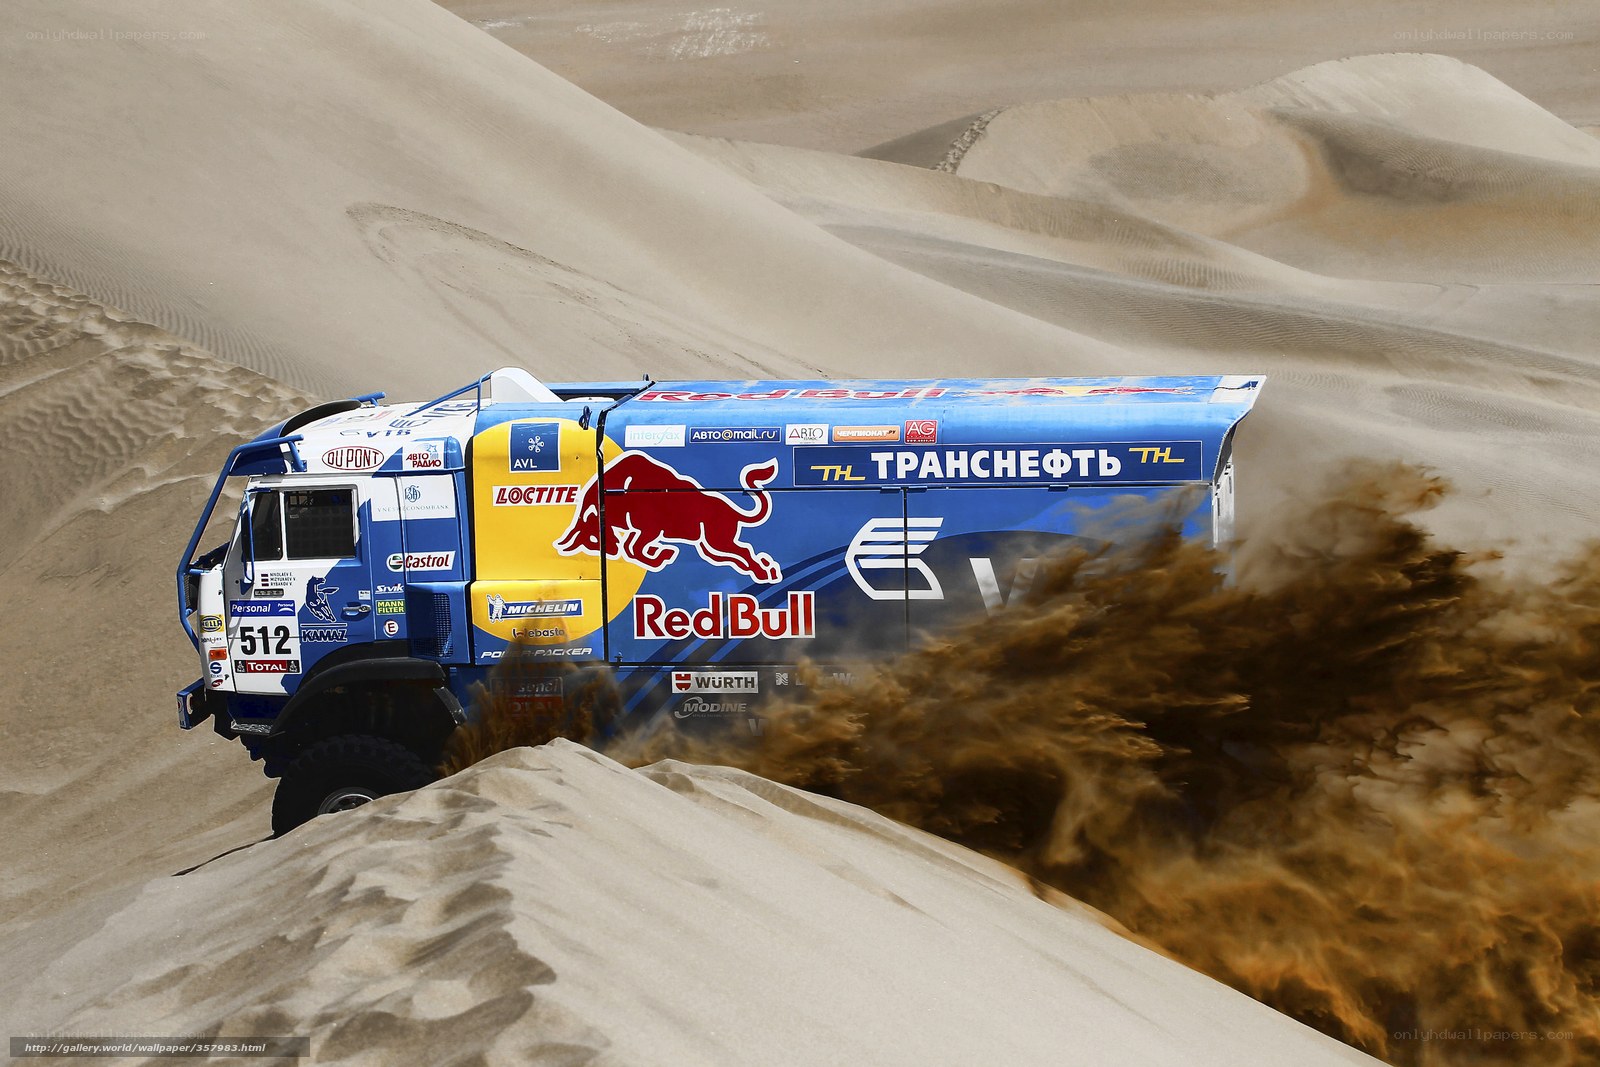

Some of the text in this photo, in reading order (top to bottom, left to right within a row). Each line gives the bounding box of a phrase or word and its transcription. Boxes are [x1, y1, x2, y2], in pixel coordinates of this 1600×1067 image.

[637, 387, 950, 402] Red Bull
[906, 421, 935, 436] AG
[514, 458, 538, 469] AVL
[871, 448, 1122, 479] ТРАНСНЕФТЬ
[495, 486, 579, 505] LOCTITE
[405, 554, 450, 569] Castrol
[231, 604, 271, 613] Personal
[507, 603, 579, 614] MICHELIN
[634, 592, 815, 639] Red Bull
[239, 625, 292, 655] 512
[301, 629, 348, 642] KAMAZ
[683, 702, 747, 713] MODINE
